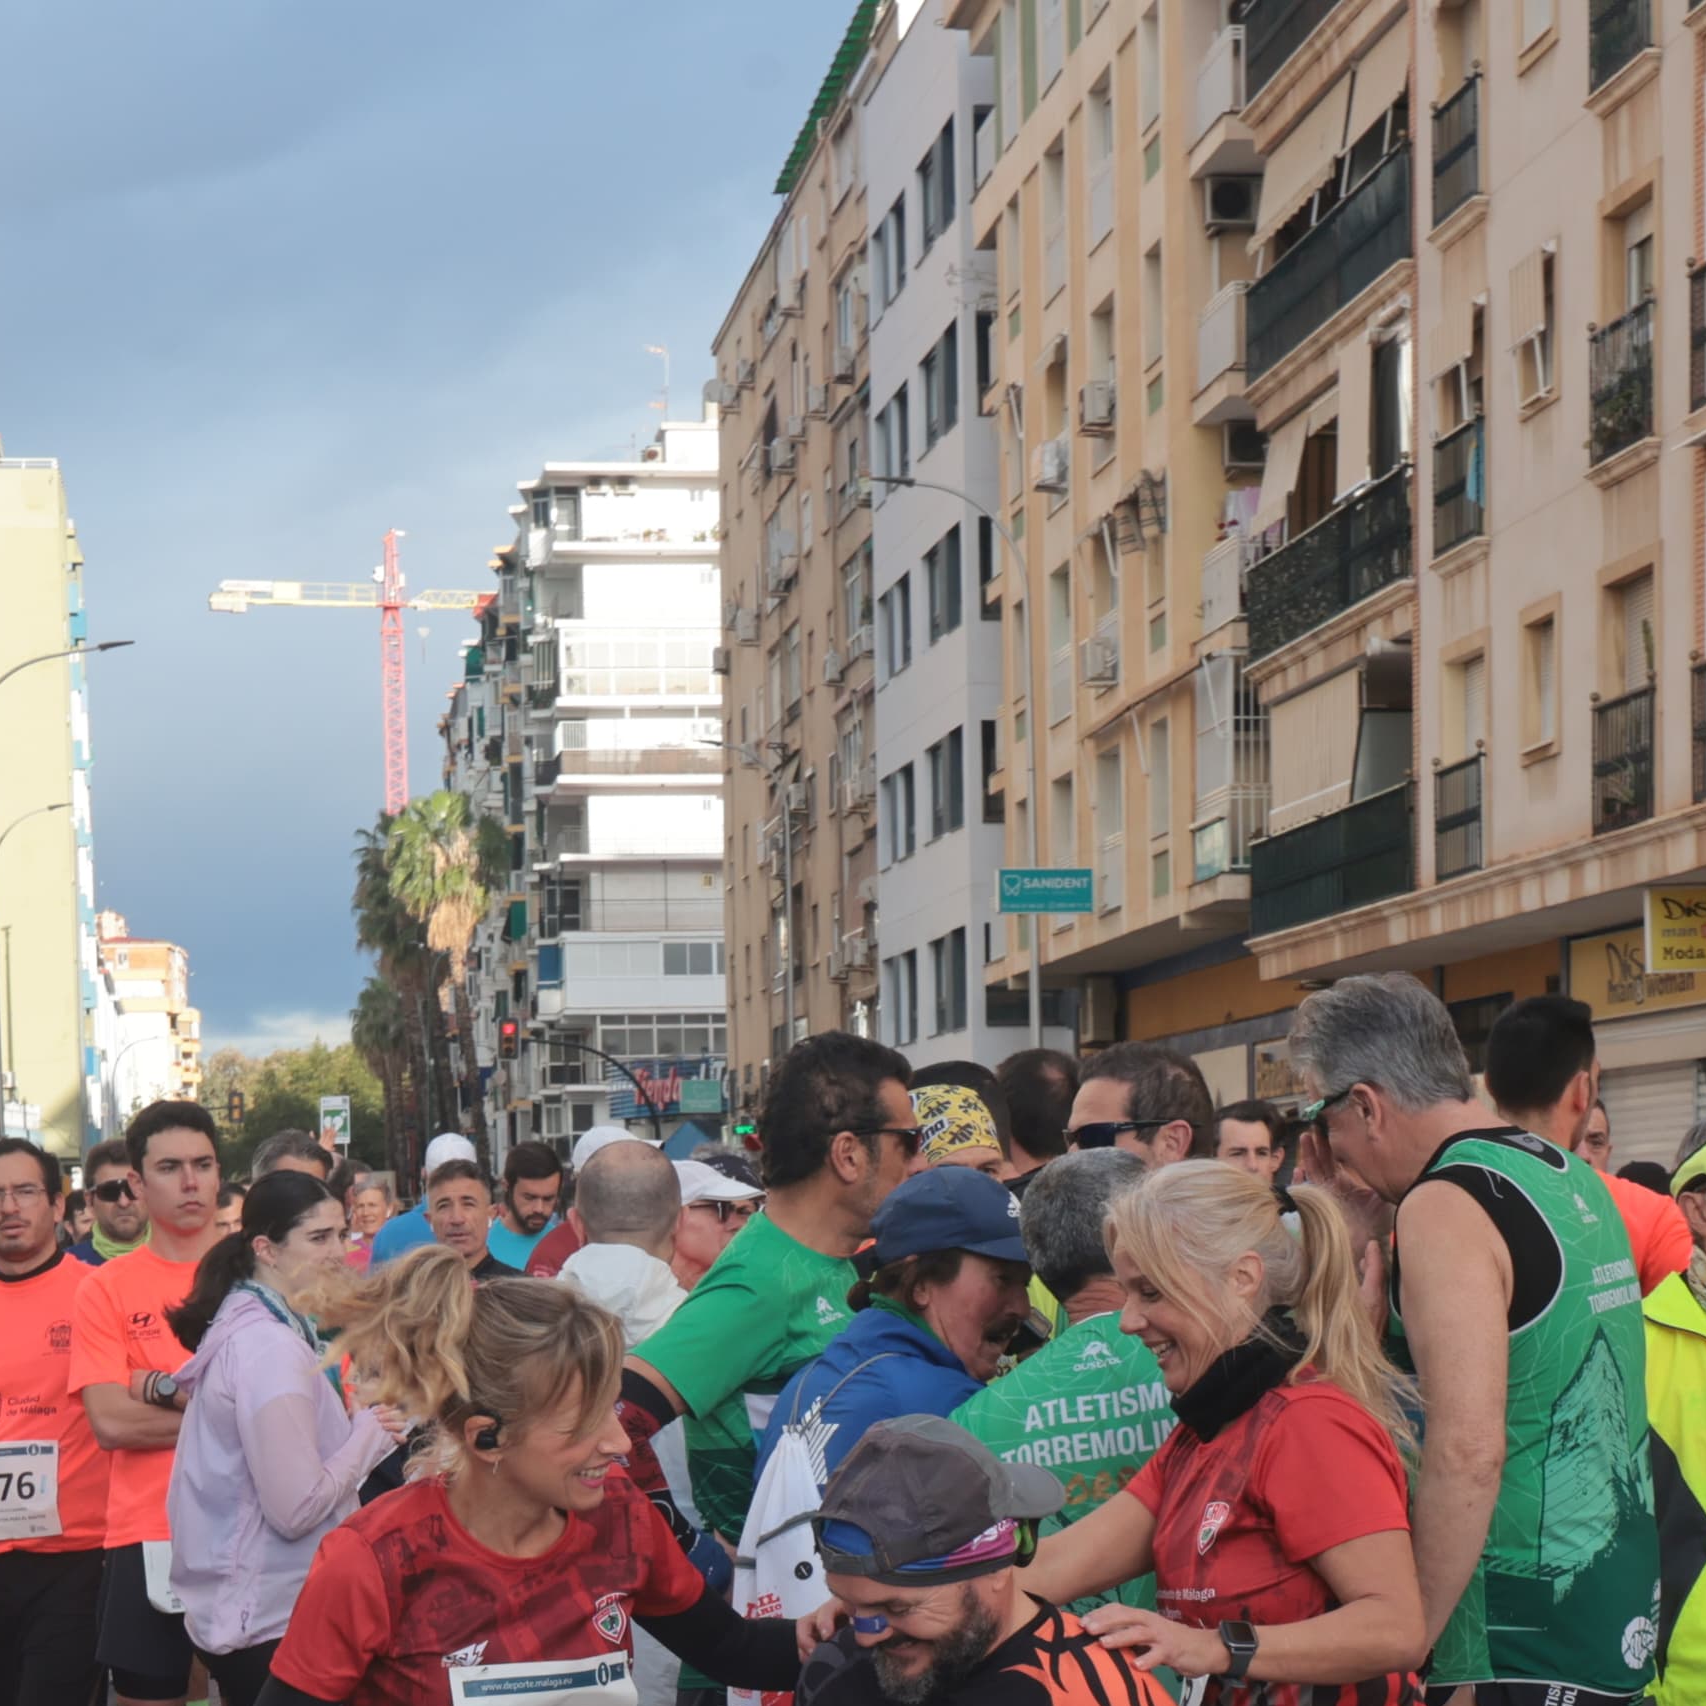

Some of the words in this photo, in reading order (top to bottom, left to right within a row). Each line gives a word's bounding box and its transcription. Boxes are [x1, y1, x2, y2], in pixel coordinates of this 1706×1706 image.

[1023, 877, 1088, 889] SANIDENT
[1663, 946, 1706, 960] Moda
[7, 1395, 41, 1407] Ciudad
[19, 1405, 57, 1416] Málaga
[480, 1677, 573, 1692] www.deporte.malaga.eu
